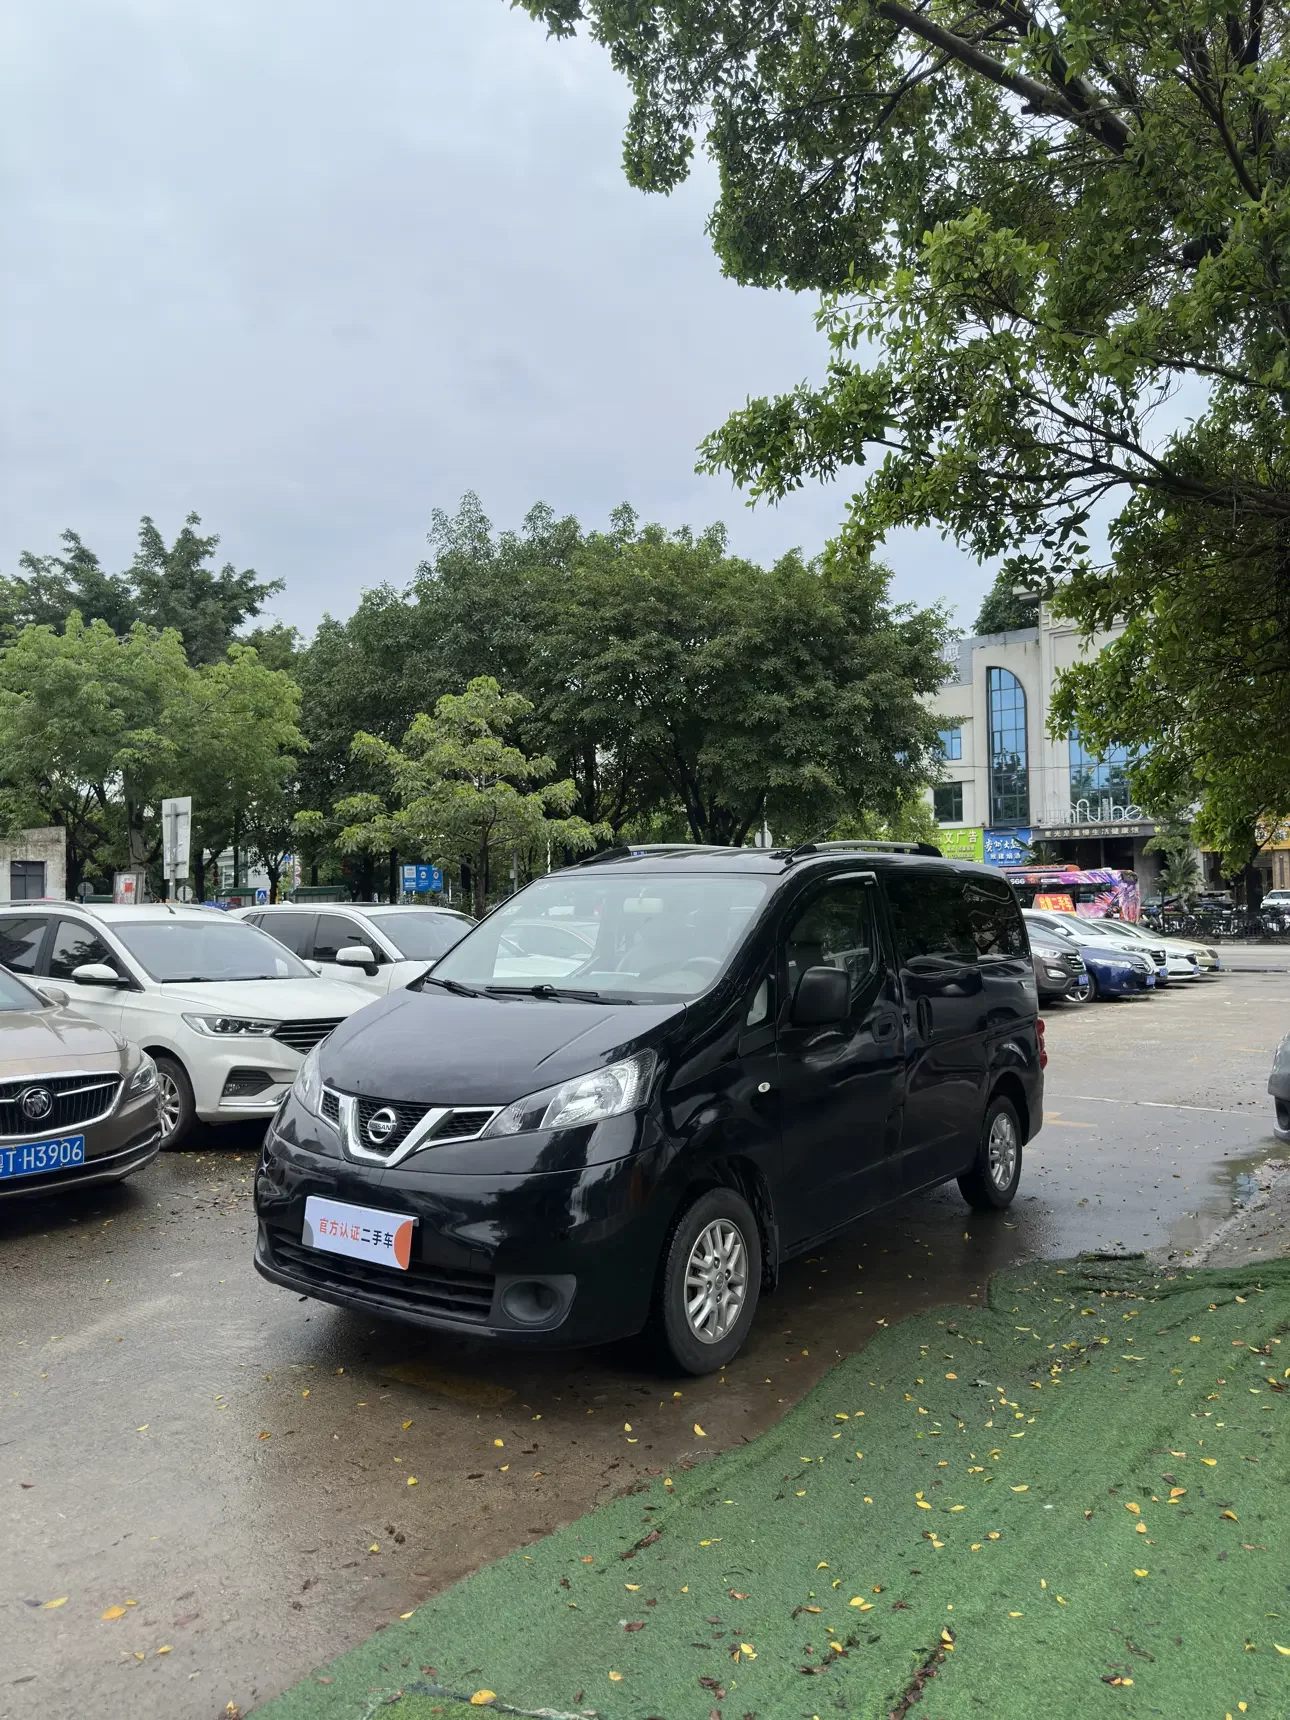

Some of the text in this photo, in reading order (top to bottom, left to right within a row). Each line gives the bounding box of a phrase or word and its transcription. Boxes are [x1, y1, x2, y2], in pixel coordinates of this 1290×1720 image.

[319, 1217, 393, 1248] 官方认证二手车
